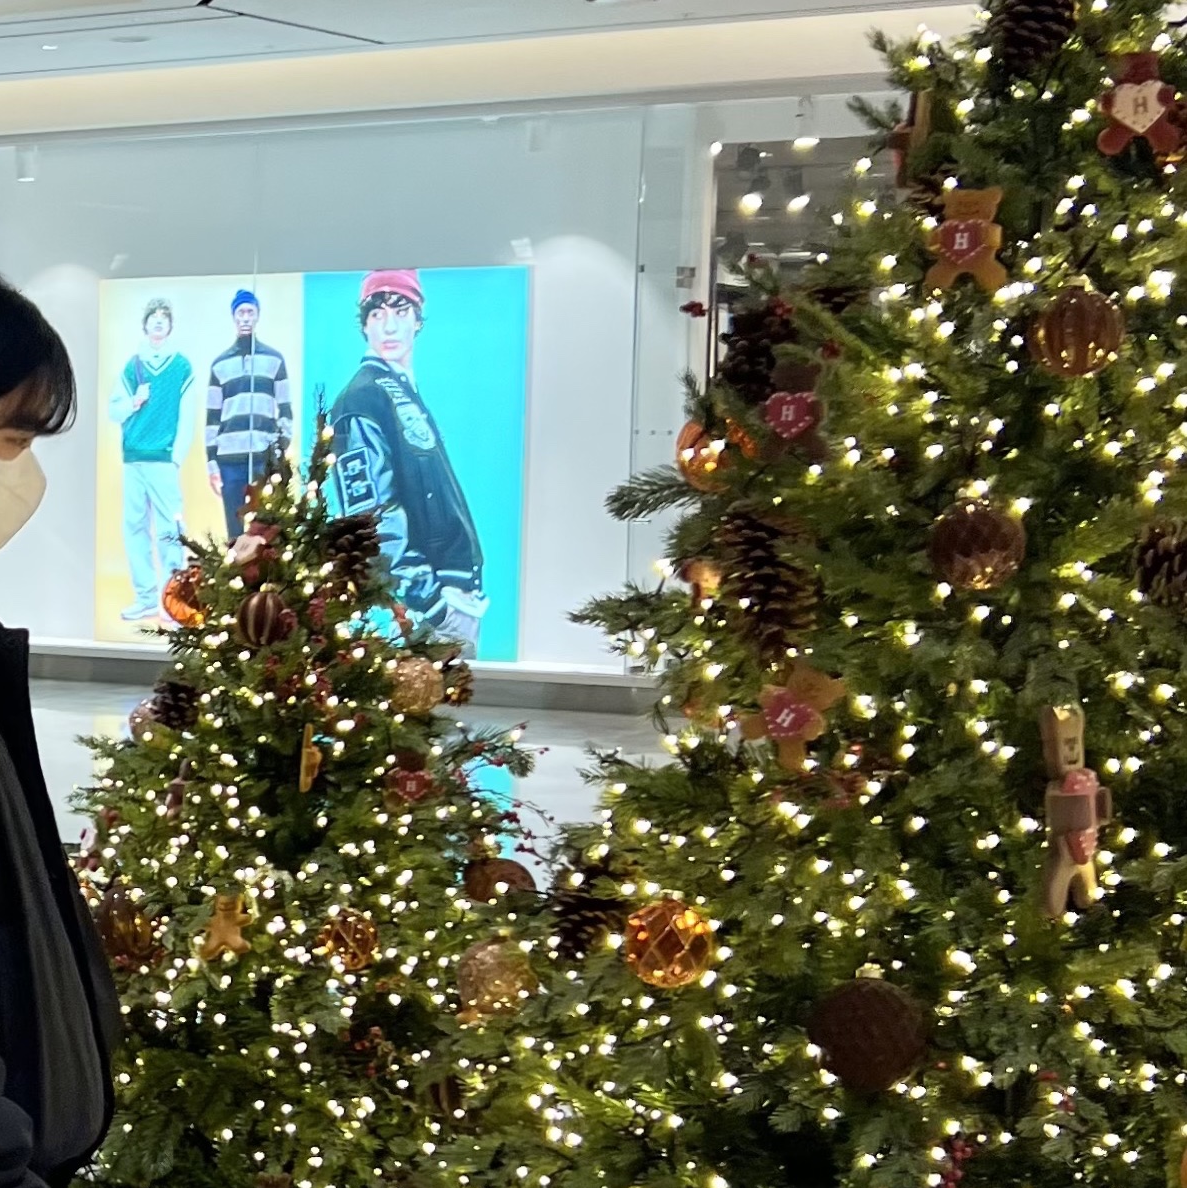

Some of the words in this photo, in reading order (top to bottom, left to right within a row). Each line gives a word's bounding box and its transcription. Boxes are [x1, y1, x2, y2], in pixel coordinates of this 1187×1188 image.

[1133, 96, 1148, 115] H
[954, 232, 969, 250] H
[781, 404, 795, 421] H
[776, 708, 796, 728] H
